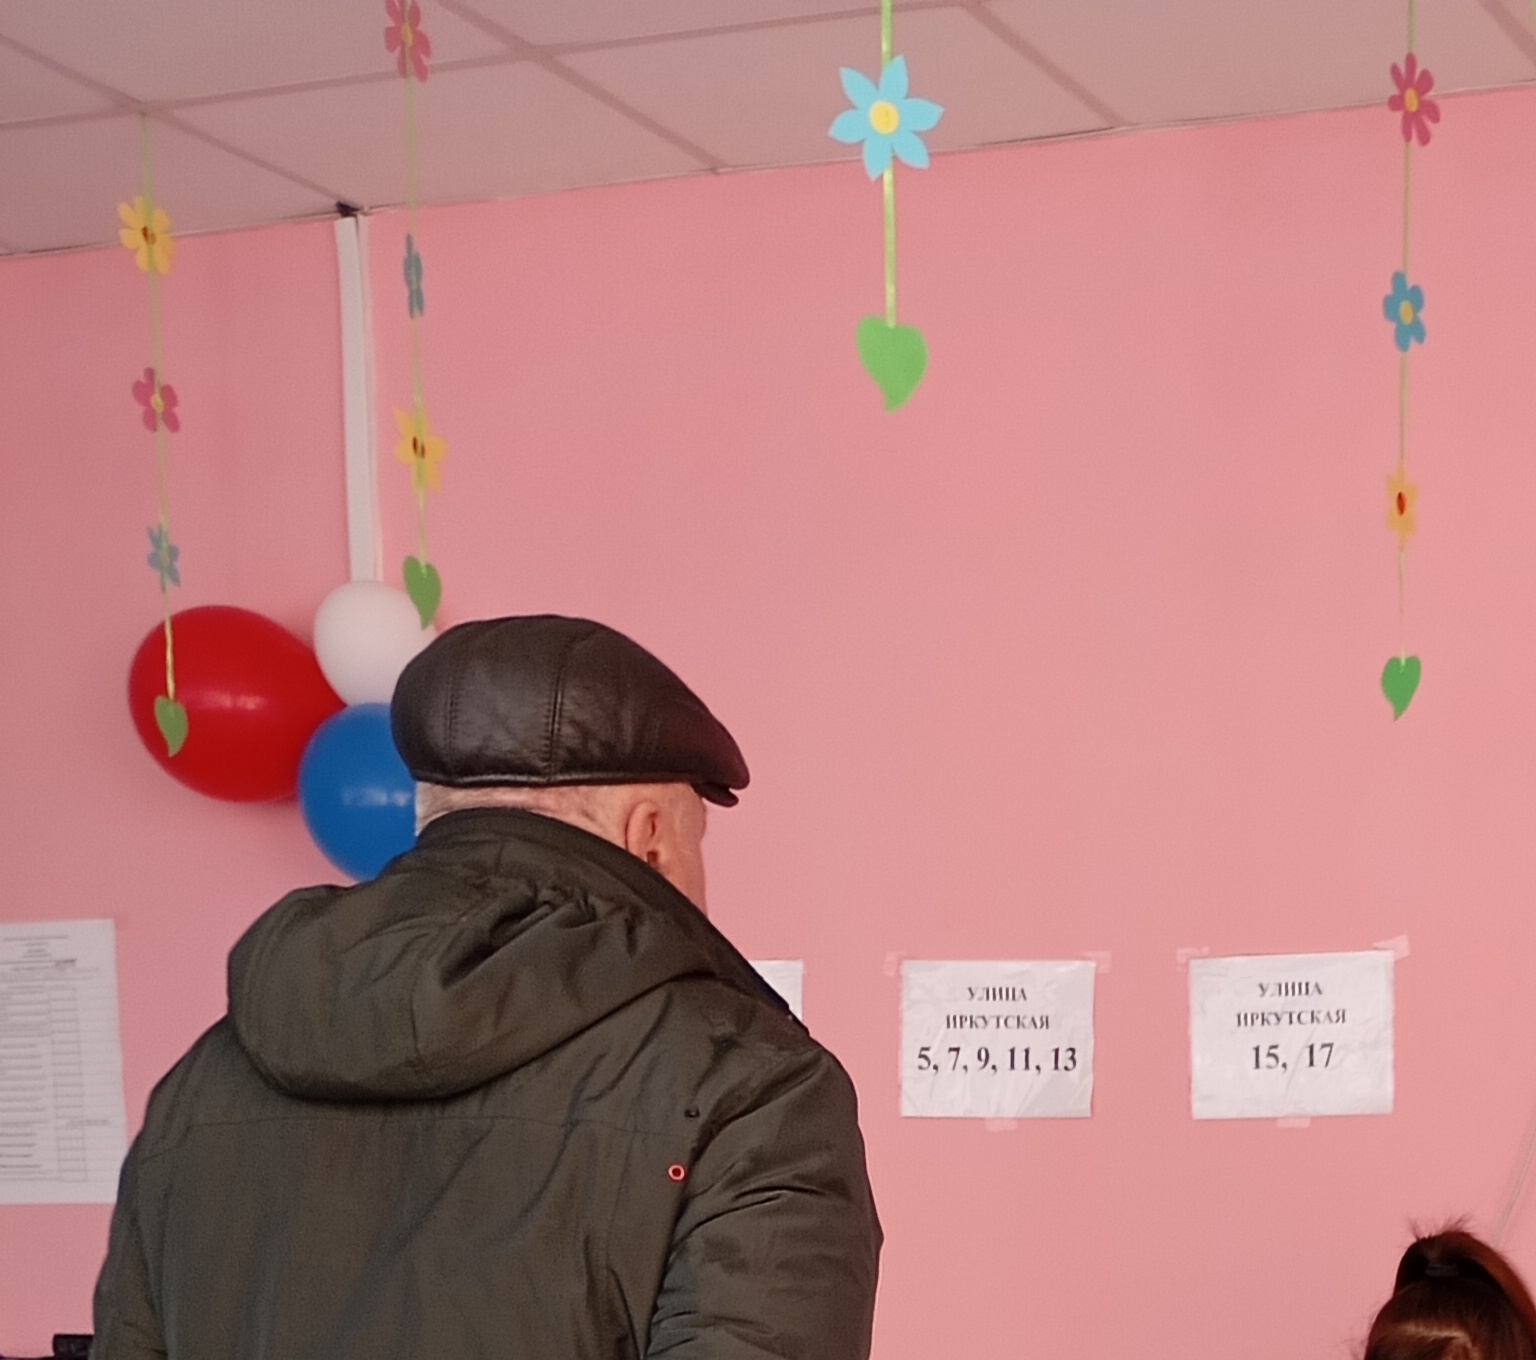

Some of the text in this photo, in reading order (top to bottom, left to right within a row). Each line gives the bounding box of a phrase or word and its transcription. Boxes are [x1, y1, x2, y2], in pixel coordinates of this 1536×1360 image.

[968, 986, 1028, 1002] УЛИЦА
[1258, 981, 1323, 998] УЛИЦА
[946, 1014, 1050, 1030] ИРКУТСКАЯ
[1236, 1008, 1346, 1028] ИРКУТСКАЯ
[918, 1046, 1077, 1076] 5, 7, 9, 11, 13
[1252, 1042, 1335, 1073] 15, 17
